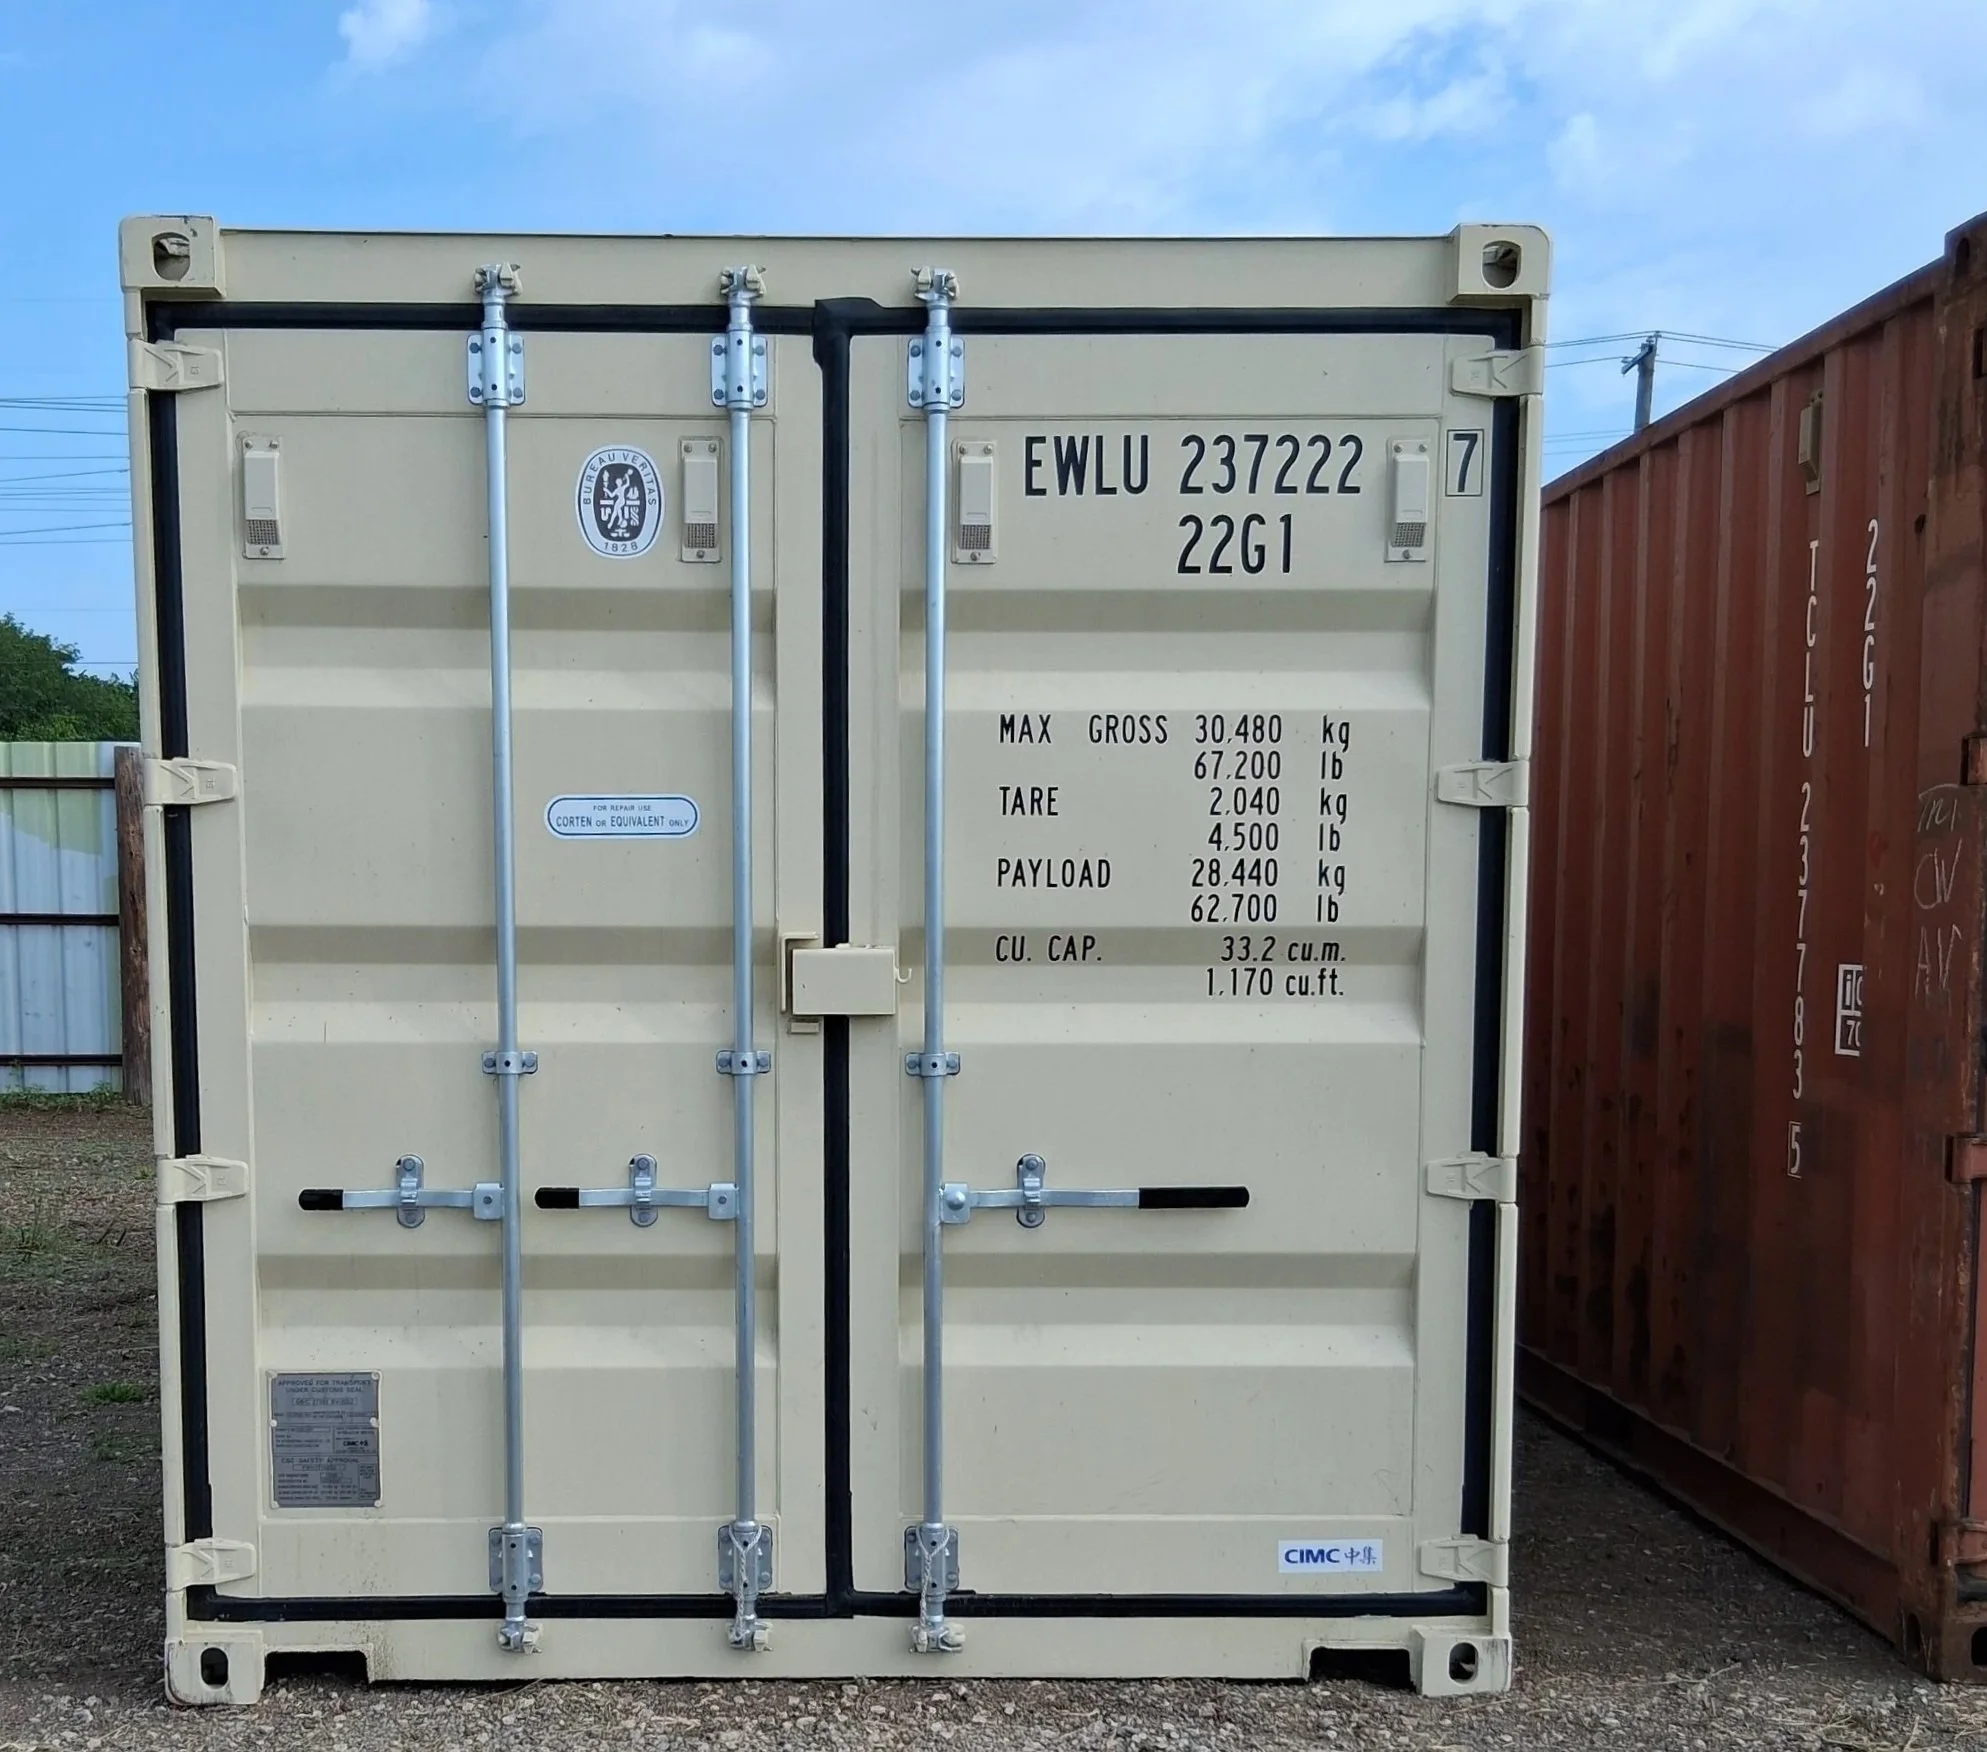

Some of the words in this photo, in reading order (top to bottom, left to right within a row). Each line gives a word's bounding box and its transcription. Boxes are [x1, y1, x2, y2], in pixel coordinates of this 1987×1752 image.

[583, 452, 615, 505] BUREAU
[622, 452, 657, 506] VERITAS
[1025, 435, 1148, 496] EWLU
[1180, 434, 1362, 494] 237222
[1453, 433, 1478, 493] 7
[604, 541, 638, 553] 1828
[1178, 513, 1292, 574] 22G1
[1802, 540, 1818, 757] TCLU
[1863, 519, 1878, 747] 22G1
[1000, 714, 1052, 744] MAX
[1089, 714, 1168, 744] GROSS
[1195, 714, 1282, 745] 30,480
[1322, 715, 1350, 752] kg
[1194, 750, 1281, 780] 67,200
[1320, 751, 1342, 780] lb
[556, 816, 592, 827] CORTEN
[595, 819, 607, 827] OR
[610, 815, 665, 828] EQUIVALENT
[669, 819, 689, 827] ONLY
[1000, 786, 1059, 816] TARE
[1209, 786, 1280, 816] 2,040
[1320, 787, 1347, 825] kg
[1208, 822, 1279, 852] 4,500
[1319, 823, 1341, 852] lb
[997, 858, 1111, 888] PAYLOAD
[1191, 858, 1278, 887] 28,440
[1318, 859, 1345, 896] kg
[1191, 894, 1277, 923] 62,700
[1317, 894, 1339, 922] lb
[996, 935, 1032, 962] CU.
[1048, 935, 1102, 962] CAP.
[1220, 935, 1276, 962] 33.2
[1287, 941, 1346, 962] cu.m.
[1792, 782, 1811, 1099] 237783
[1207, 967, 1273, 996] 1,170
[1285, 967, 1344, 996] cu.ft.
[1790, 1125, 1801, 1174] 5
[1284, 1548, 1340, 1564] CIMC
[1344, 1546, 1377, 1565] 中集
